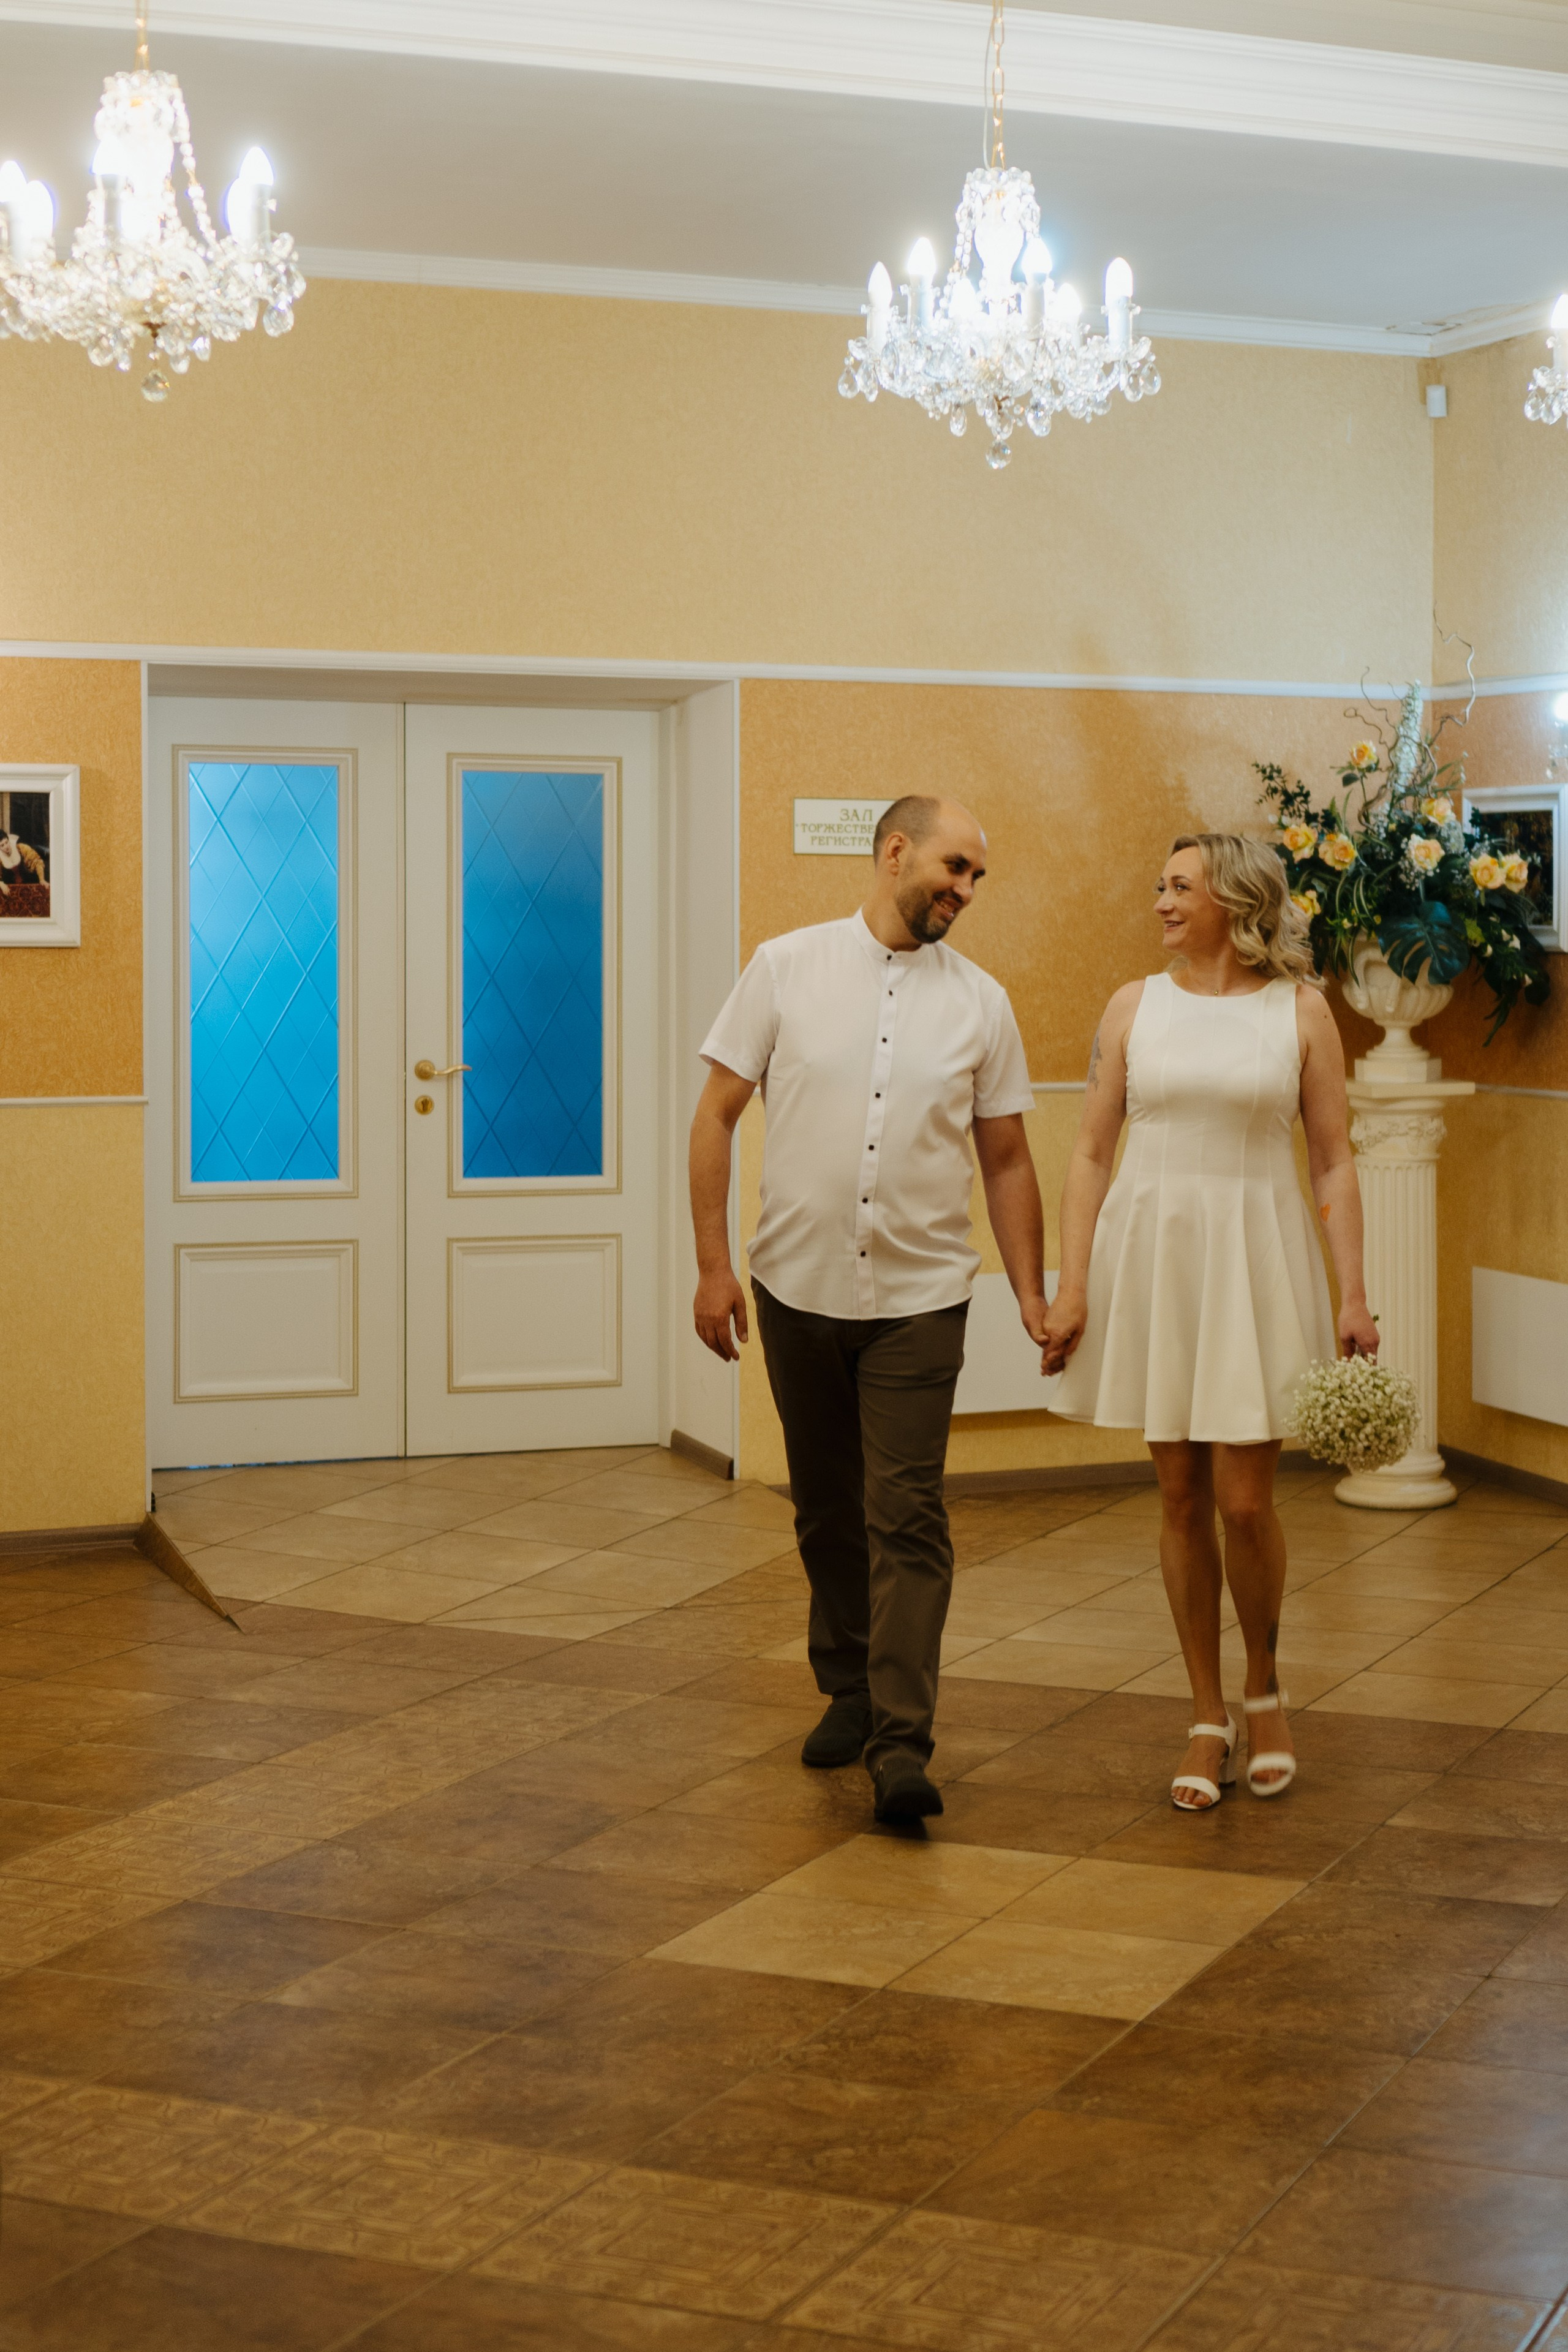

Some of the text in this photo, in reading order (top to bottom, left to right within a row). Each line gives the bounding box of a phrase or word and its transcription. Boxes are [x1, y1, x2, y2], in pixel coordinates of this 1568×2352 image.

[840, 809, 873, 821] ЗАЛ
[801, 823, 875, 834] ТОРЖЕСТВЕ
[810, 836, 872, 846] РЕГИСТРА
